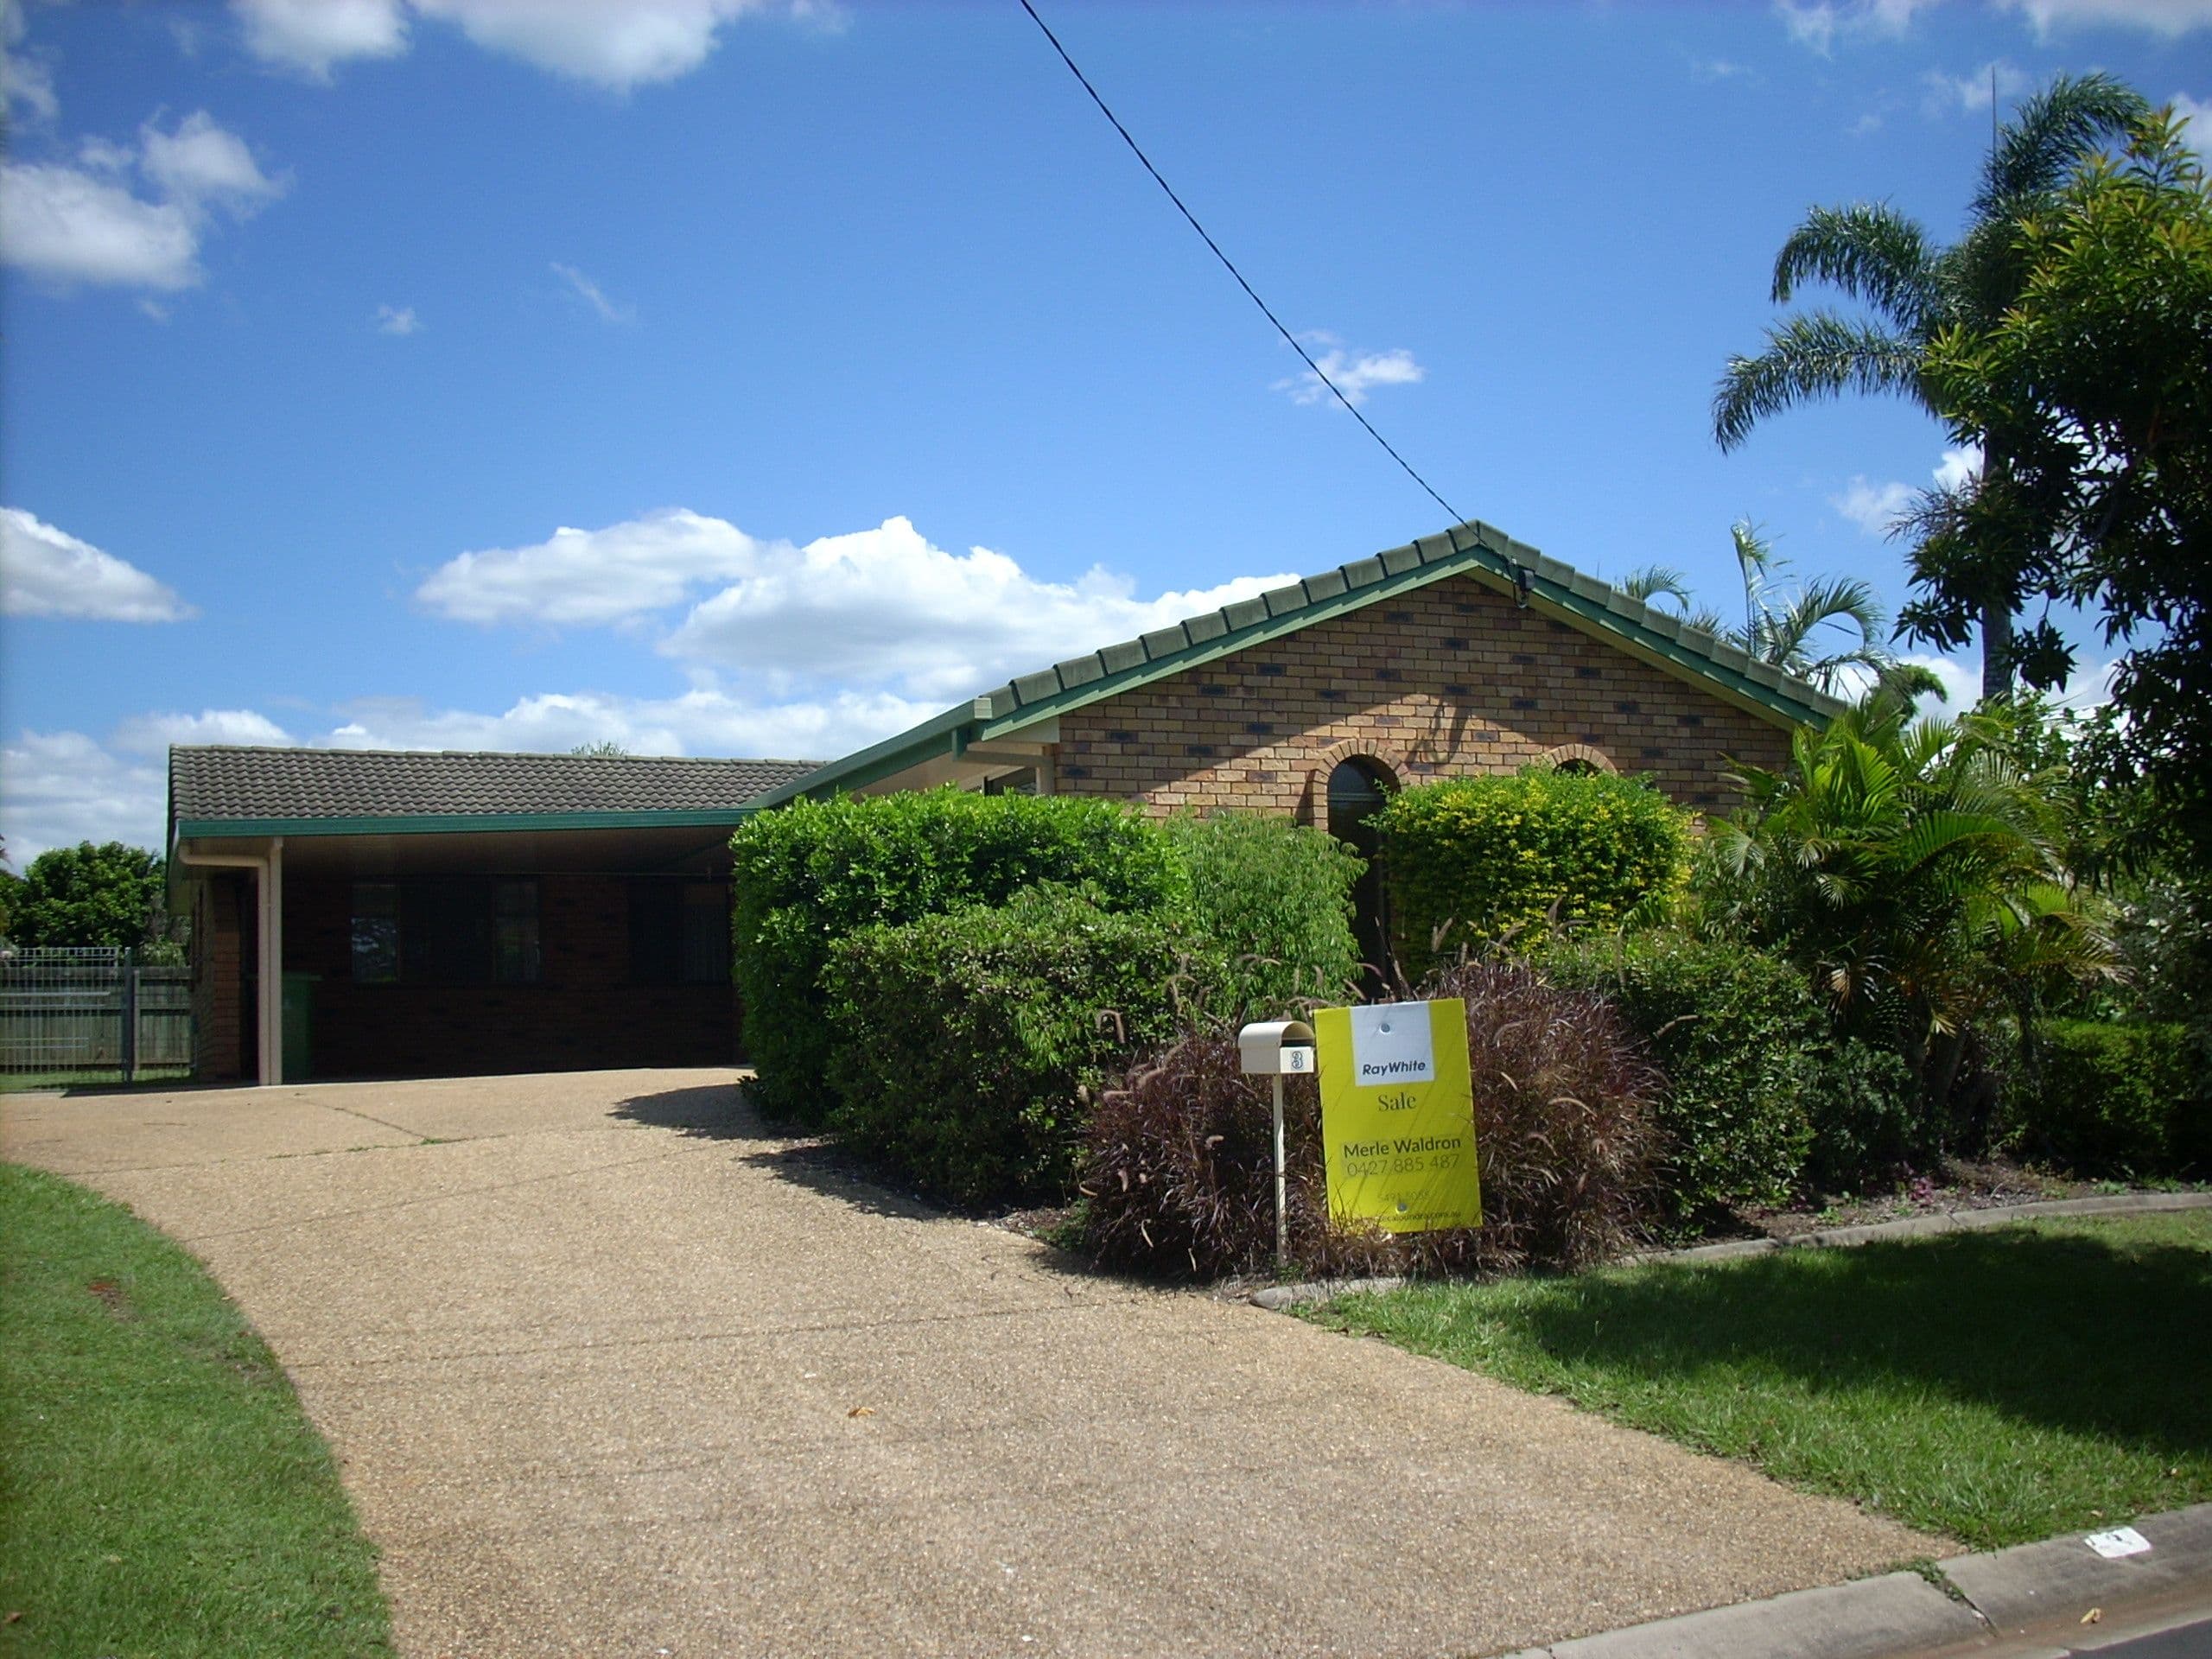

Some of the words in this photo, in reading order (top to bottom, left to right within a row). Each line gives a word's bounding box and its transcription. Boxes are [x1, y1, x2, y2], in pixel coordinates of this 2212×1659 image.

[1292, 1051, 1303, 1070] 3
[1378, 1092, 1417, 1111] Sale
[1344, 1142, 1389, 1159] Merle
[1394, 1136, 1461, 1154] Waldron
[1347, 1160, 1388, 1177] 0427
[1394, 1157, 1424, 1173] 885
[1431, 1154, 1459, 1169] 487
